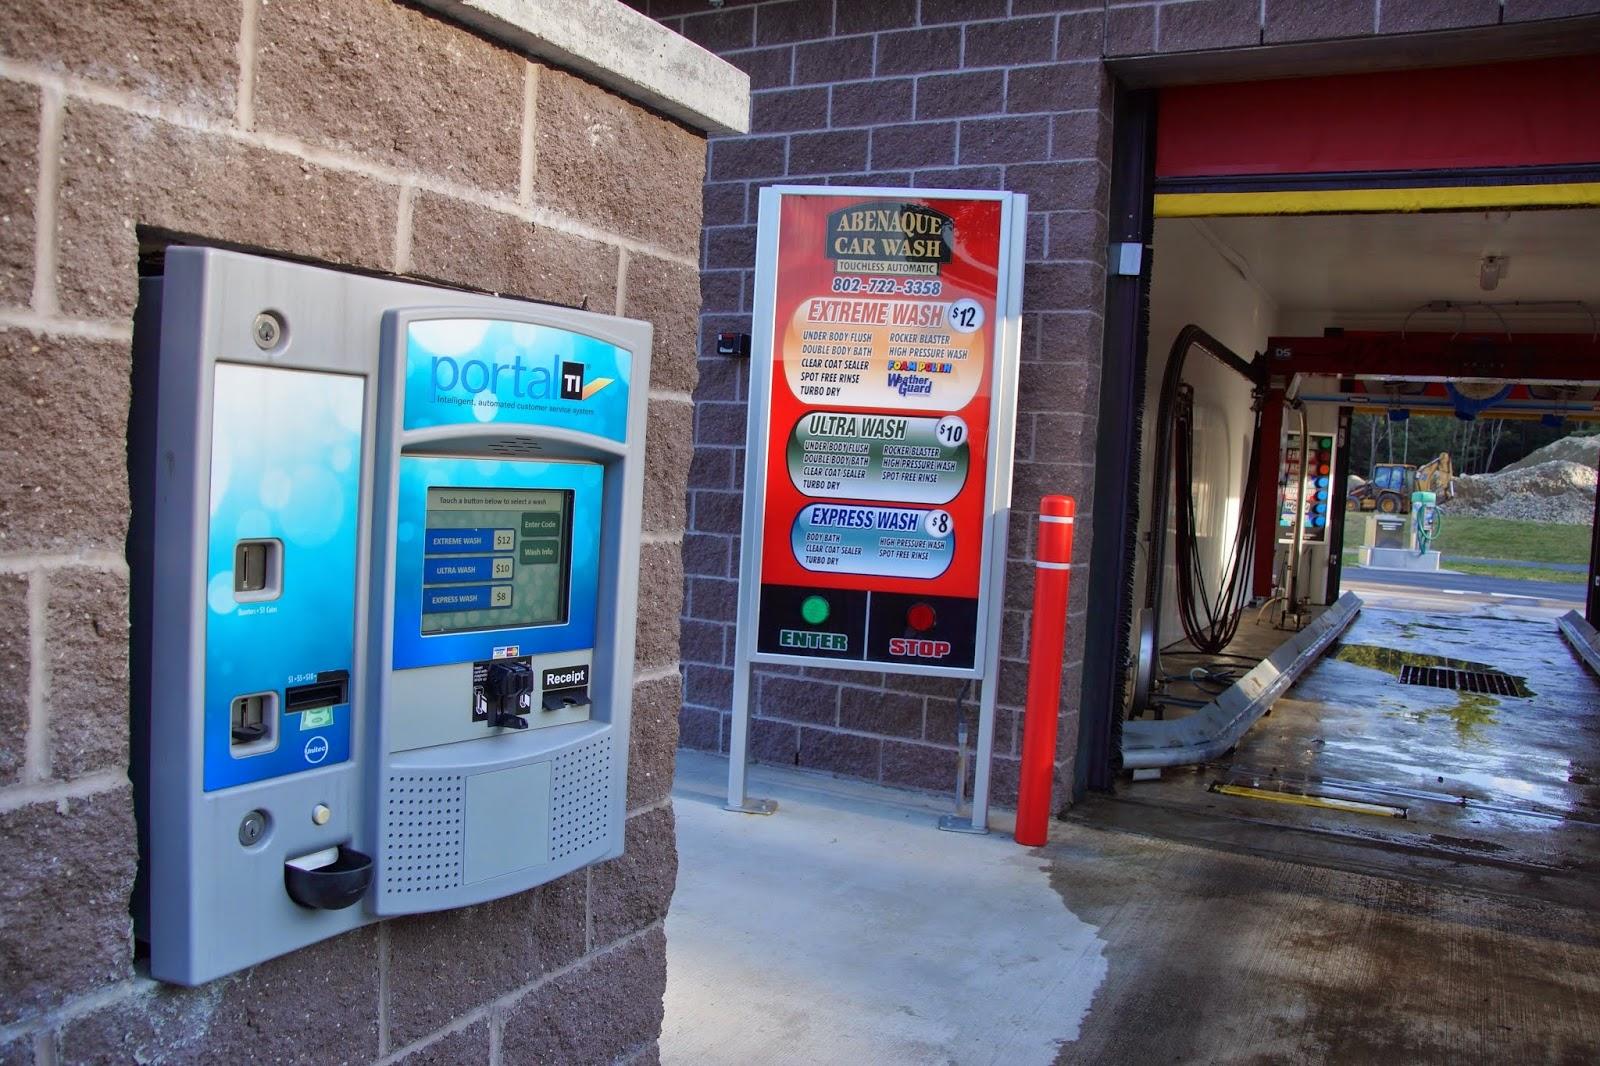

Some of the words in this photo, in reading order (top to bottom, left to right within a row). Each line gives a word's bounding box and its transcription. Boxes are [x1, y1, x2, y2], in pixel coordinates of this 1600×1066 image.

[837, 209, 943, 236] ABENAQUE
[834, 237, 876, 256] CAR
[881, 239, 941, 258] WASH
[840, 260, 885, 272] TOUCHLESS
[887, 263, 935, 274] AUTOMATIC
[832, 278, 941, 296] 802-722-3358
[807, 300, 889, 325] EXTREME
[891, 302, 944, 328] WASH
[952, 307, 976, 327] $12
[803, 331, 827, 342] UNDER
[829, 332, 849, 343] BODY
[850, 333, 872, 343] FLUSH
[889, 333, 917, 343] ROCKER
[918, 334, 950, 345] BLASTER
[802, 345, 830, 355] DOUBLE
[832, 346, 851, 356] BODY
[853, 347, 872, 357] BATH
[889, 346, 906, 356] HIGH
[908, 348, 945, 359] PRESSURE
[947, 350, 968, 360] WASH
[801, 359, 822, 368] CLEAR
[824, 359, 842, 369] COAT
[844, 360, 869, 371] SEALER
[887, 360, 917, 372] FOAM
[918, 361, 953, 374] POLISH
[431, 354, 560, 403] portal
[801, 371, 819, 382] SPOT
[820, 372, 838, 383] FREE
[839, 373, 860, 384] RINSE
[887, 373, 929, 388] Weather
[800, 385, 824, 396] TURBO
[826, 386, 841, 397] DRY
[898, 381, 932, 397] Guard
[478, 398, 515, 409] automated
[517, 402, 548, 411] customer
[549, 406, 573, 414] service
[573, 407, 594, 416] system
[808, 415, 856, 439] ULTRA
[860, 417, 907, 440] WASH
[940, 424, 963, 442] $10
[804, 441, 827, 451] UNDER
[829, 442, 847, 453] BODY
[848, 443, 869, 454] FLUSH
[884, 446, 909, 456] ROCKER
[910, 447, 940, 458] BLASTER
[804, 454, 829, 464] DOUBLE
[830, 455, 849, 465] BODY
[850, 456, 869, 466] BATH
[883, 459, 900, 468] HIGH
[901, 460, 936, 470] PRESSURE
[936, 461, 956, 471] WASH
[804, 466, 822, 477] CLEAR
[824, 467, 841, 478] COAT
[842, 468, 865, 479] SEALER
[882, 471, 899, 481] SPOT
[901, 472, 918, 482] FREE
[919, 473, 938, 483] RINSE
[803, 479, 826, 489] TURBO
[826, 480, 840, 491] DRY
[810, 507, 873, 529] EXPRESS
[877, 511, 919, 531] WASH
[932, 513, 948, 533] $8
[433, 537, 462, 545] EXTREME
[497, 535, 511, 546] $12
[806, 532, 824, 542] BODY
[825, 533, 840, 543] BATH
[879, 537, 896, 546] HIGH
[897, 538, 927, 548] PRESSURE
[927, 540, 945, 550] WASH
[525, 548, 541, 556] Wash
[541, 548, 554, 556] Info
[806, 544, 823, 553] CLEAR
[824, 545, 840, 554] COAT
[841, 546, 862, 555] SEALER
[879, 548, 895, 558] SPOT
[896, 549, 910, 559] FREE
[911, 550, 929, 560] RINSE
[805, 556, 826, 565] TURBO
[827, 557, 839, 566] DRY
[457, 566, 476, 574] WASH
[496, 563, 510, 573] $10
[432, 596, 459, 604] EXPRESS
[459, 595, 478, 603] WASH
[496, 591, 506, 601] $8
[780, 629, 848, 650] ENTER
[888, 638, 951, 657] STOP
[547, 670, 584, 685] Receipt
